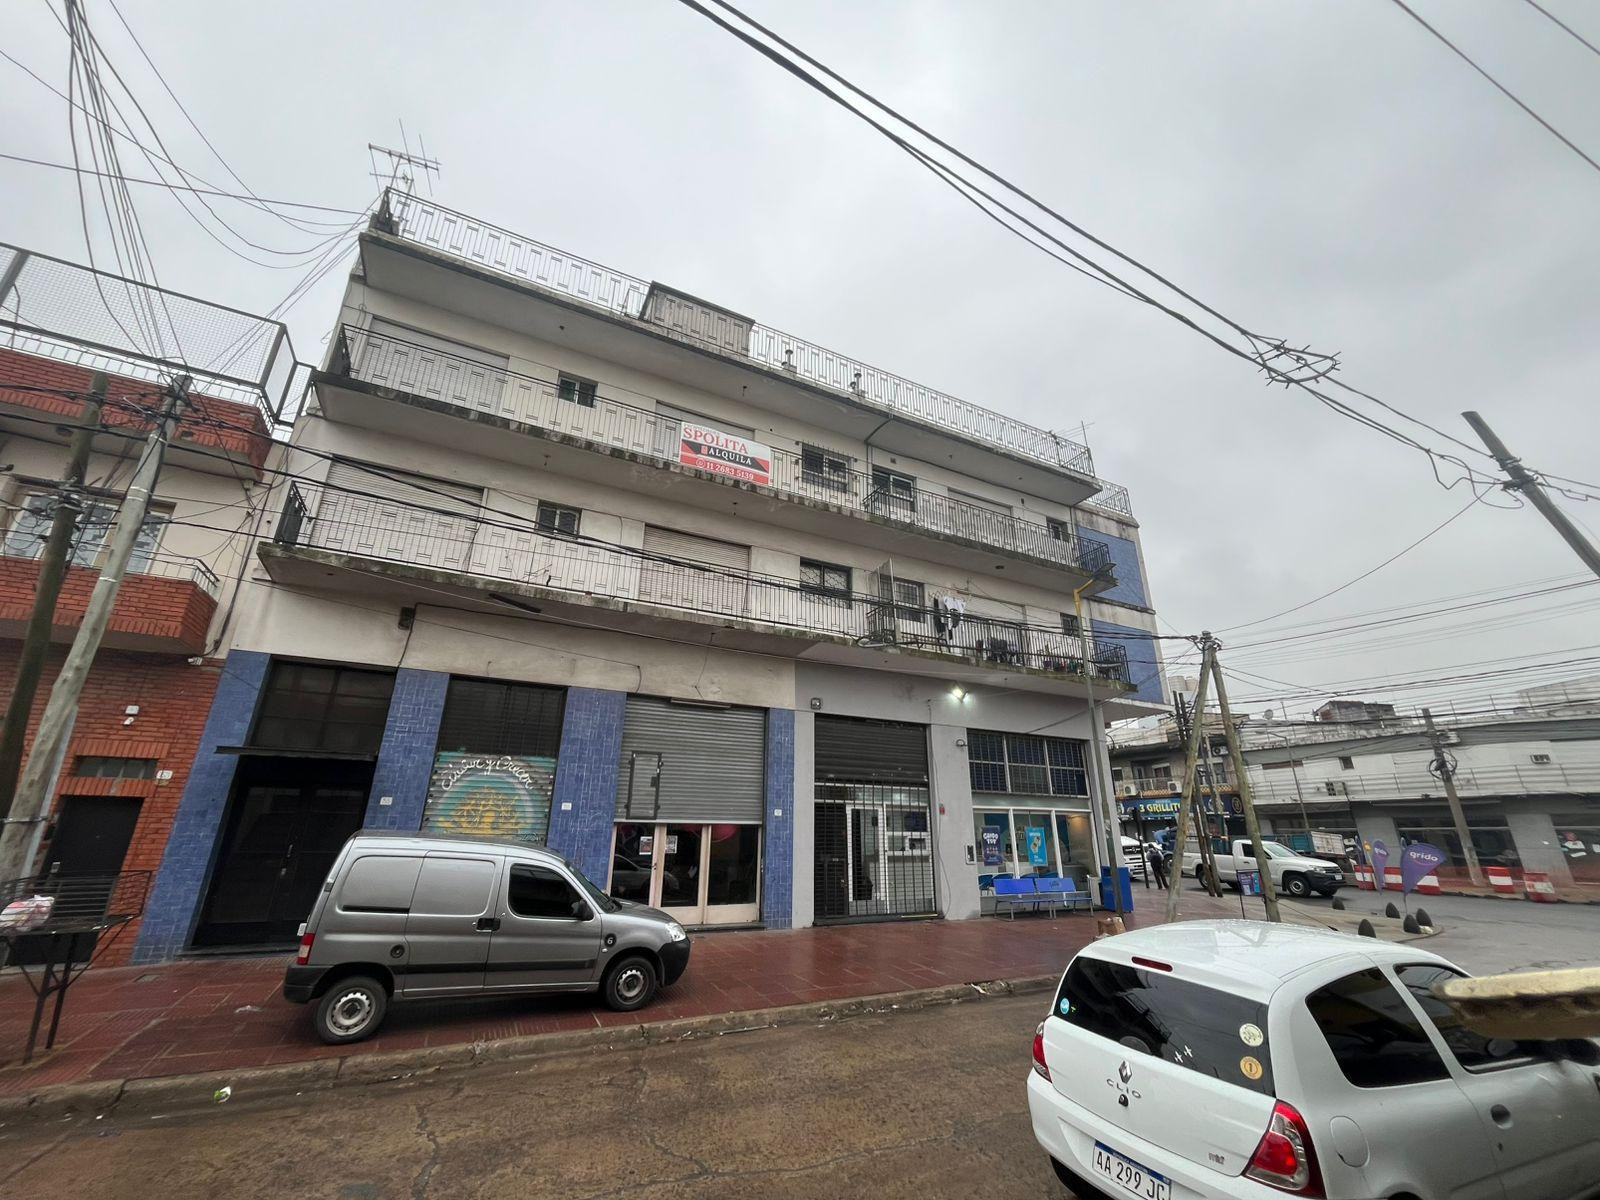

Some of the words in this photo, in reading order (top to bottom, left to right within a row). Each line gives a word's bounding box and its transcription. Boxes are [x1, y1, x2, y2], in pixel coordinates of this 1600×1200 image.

[683, 427, 748, 455] SPOLITA
[709, 447, 752, 466] ALQUILA
[1409, 851, 1439, 862] grido
[1106, 1078, 1142, 1099] CLIO
[1096, 1151, 1112, 1175] AA
[1116, 1161, 1142, 1190] 299
[1146, 1179, 1165, 1200] JC
